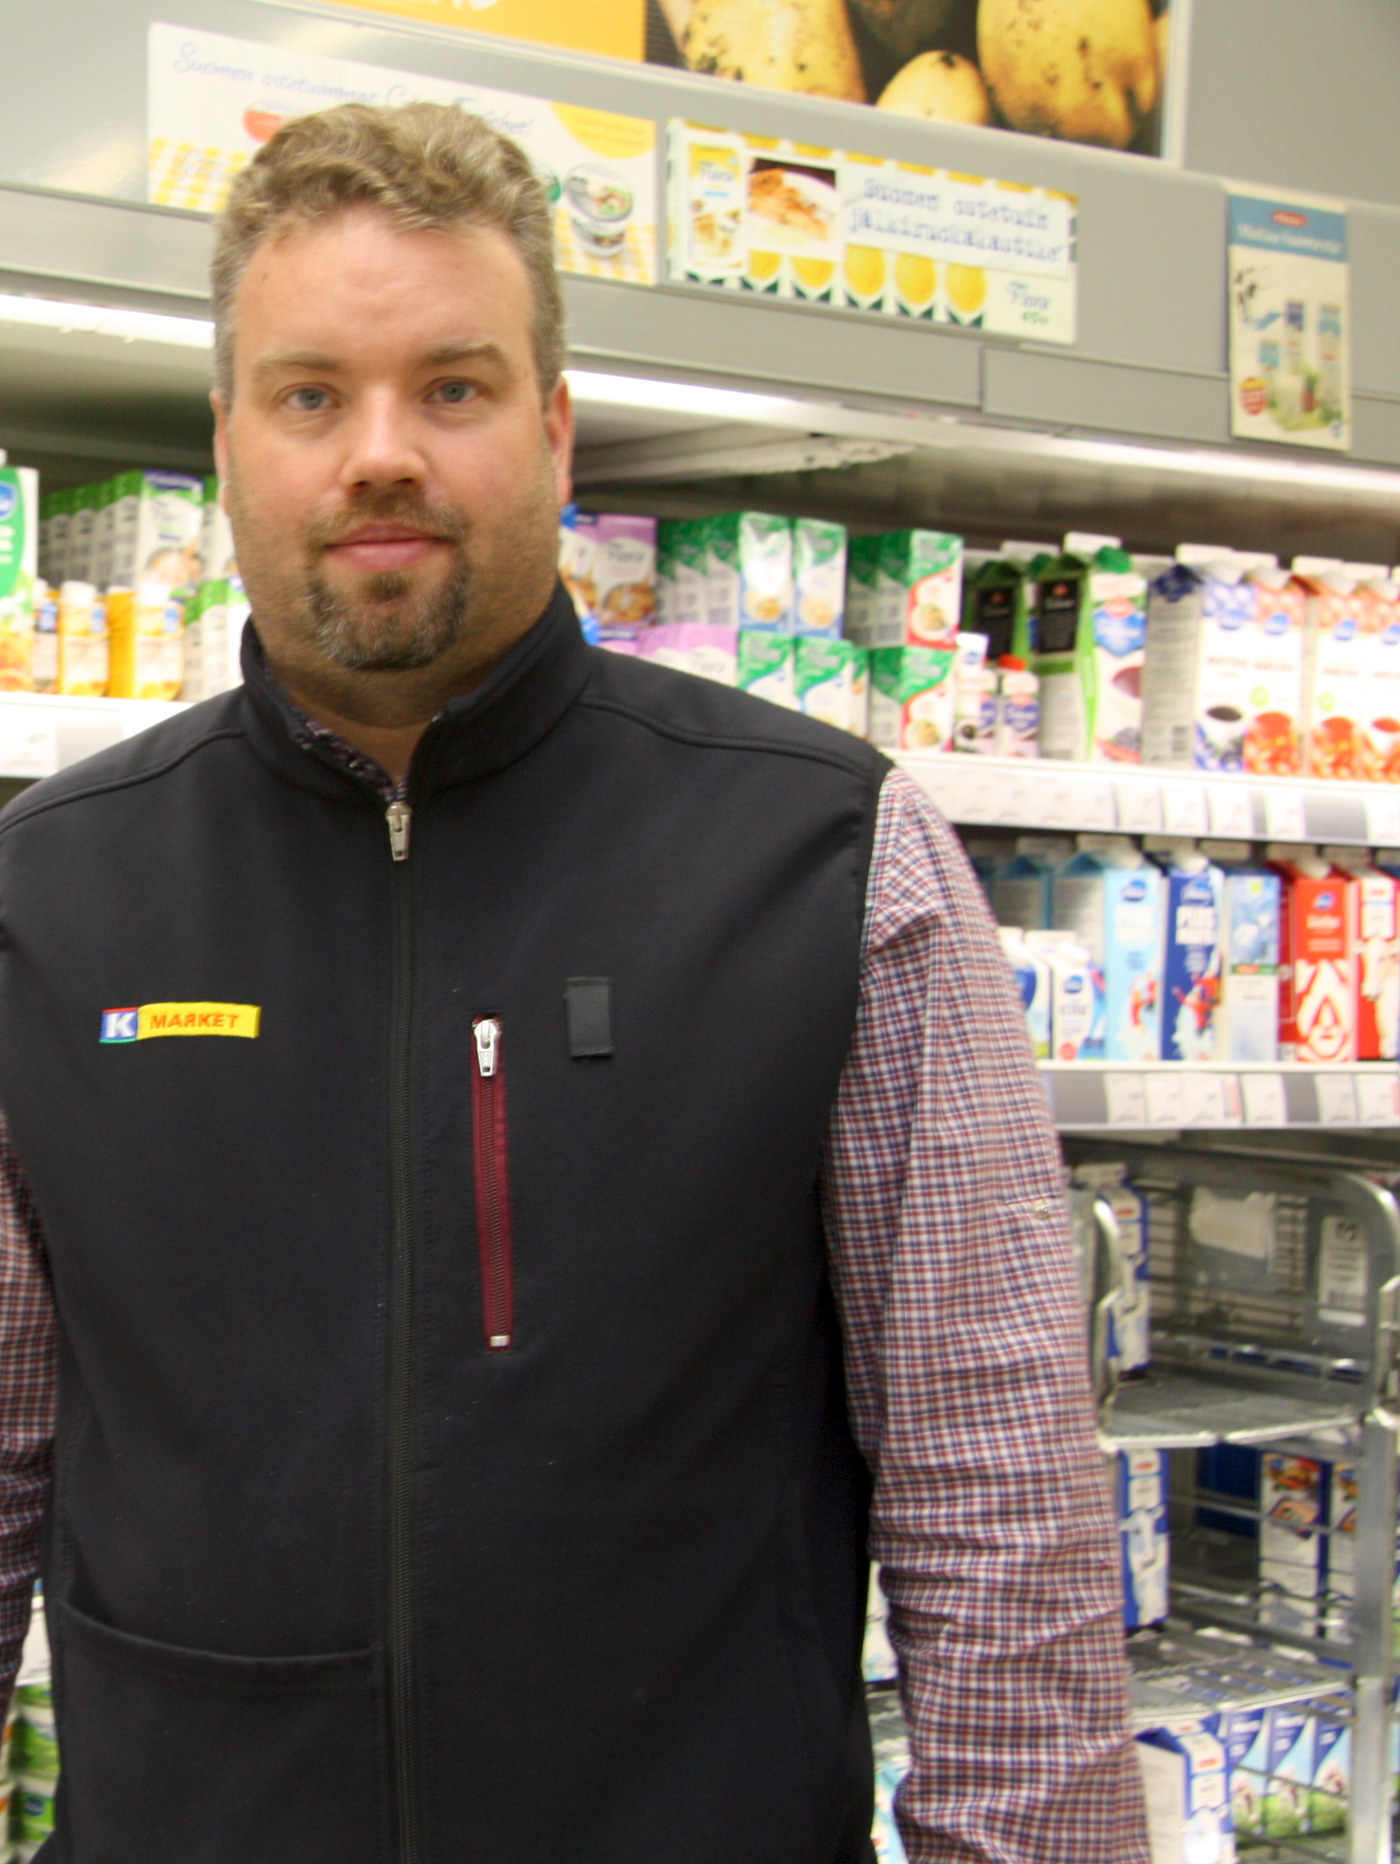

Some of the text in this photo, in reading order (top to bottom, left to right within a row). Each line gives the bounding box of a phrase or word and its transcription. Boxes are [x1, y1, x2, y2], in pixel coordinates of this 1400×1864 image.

[864, 178, 940, 211] Suomen
[105, 1012, 240, 1038] K MARKET
